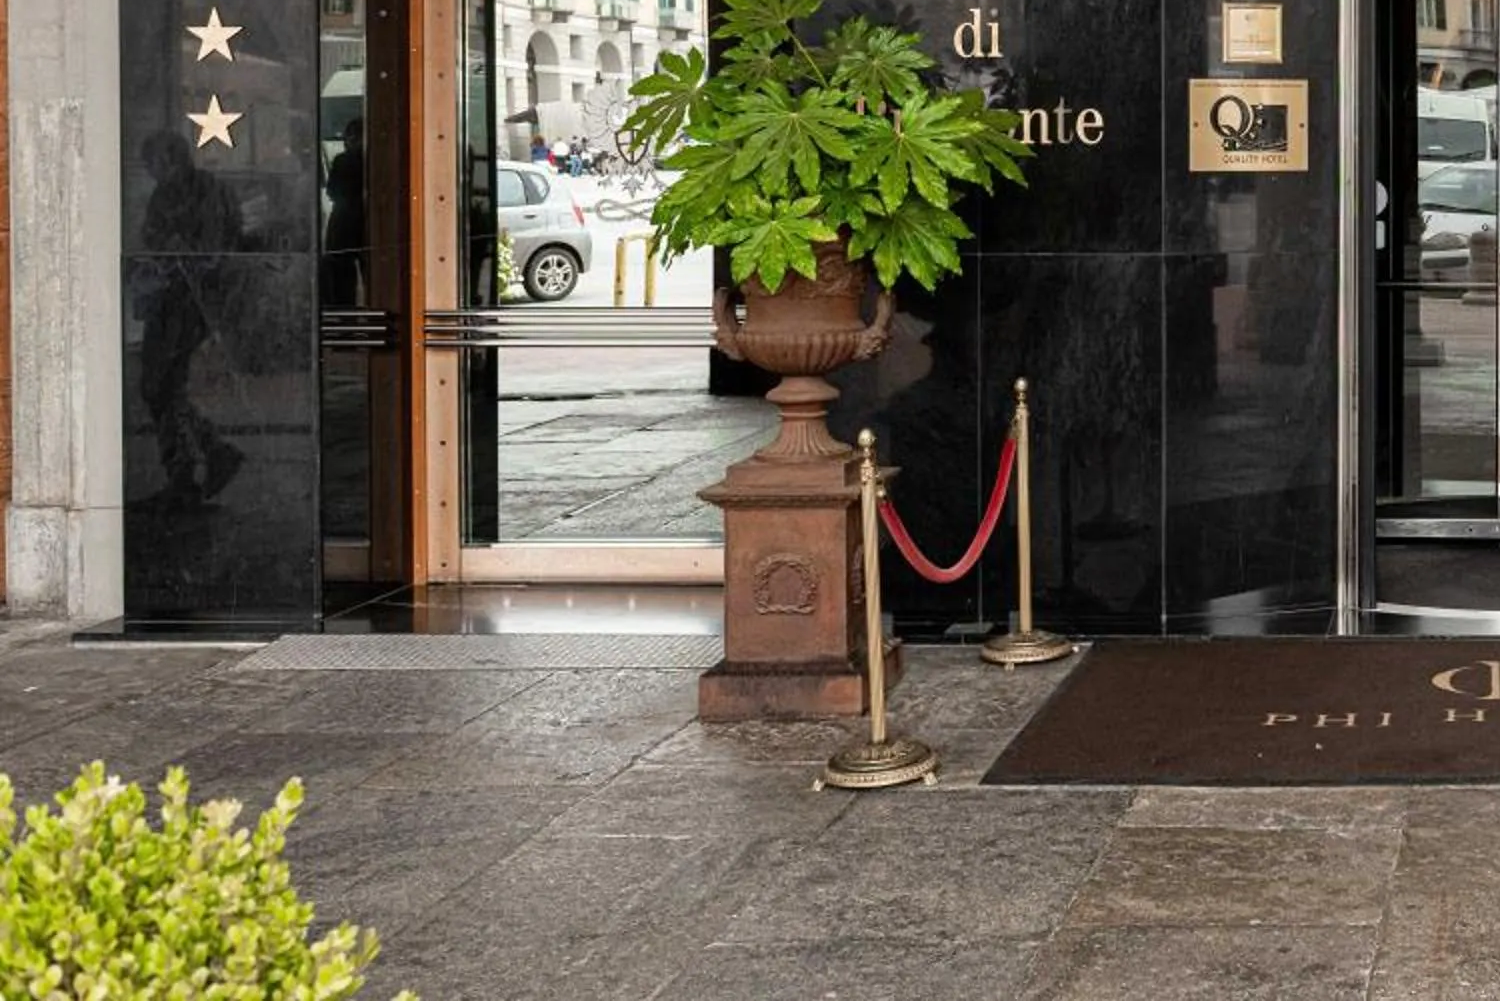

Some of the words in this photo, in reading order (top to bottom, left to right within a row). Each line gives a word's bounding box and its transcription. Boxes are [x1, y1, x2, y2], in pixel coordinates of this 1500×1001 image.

[953, 8, 1003, 59] di
[1222, 154, 1259, 165] QUALITY
[1261, 154, 1288, 165] HOTEL
[1261, 710, 1394, 728] PHI
